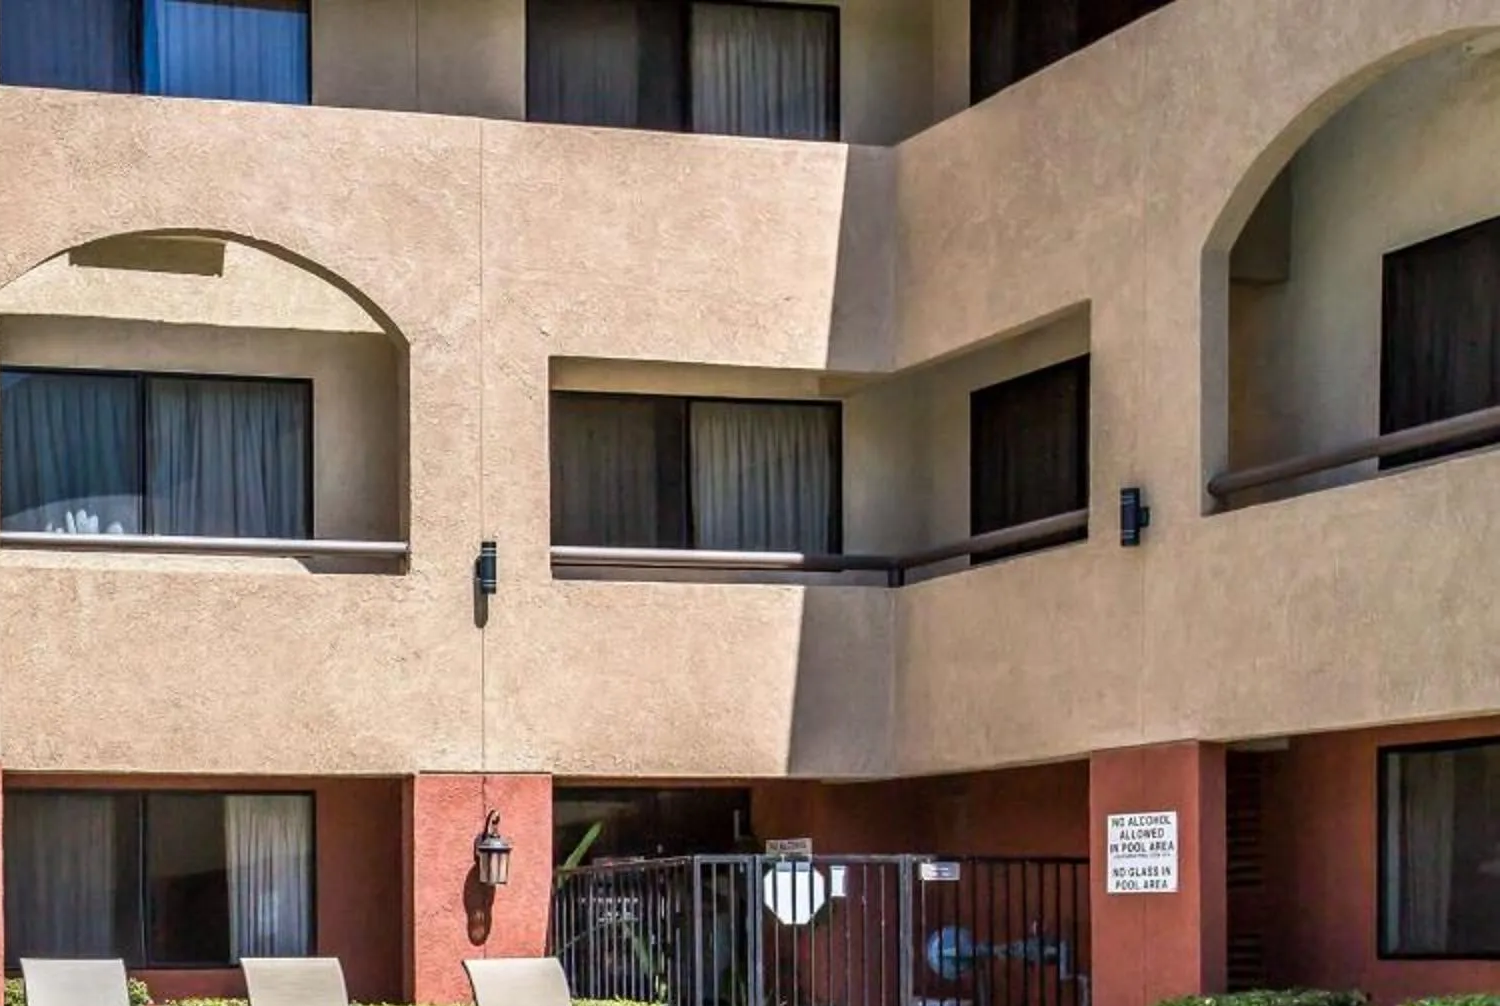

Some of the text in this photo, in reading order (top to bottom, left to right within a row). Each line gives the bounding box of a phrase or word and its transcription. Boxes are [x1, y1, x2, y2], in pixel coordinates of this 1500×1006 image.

[1112, 817, 1125, 827] NO
[1120, 828, 1164, 840] ALLOWED
[1110, 841, 1174, 853] IN POOL AREA
[1113, 866, 1171, 878] NO GLASS IN
[1115, 880, 1168, 890] POOL AREA
